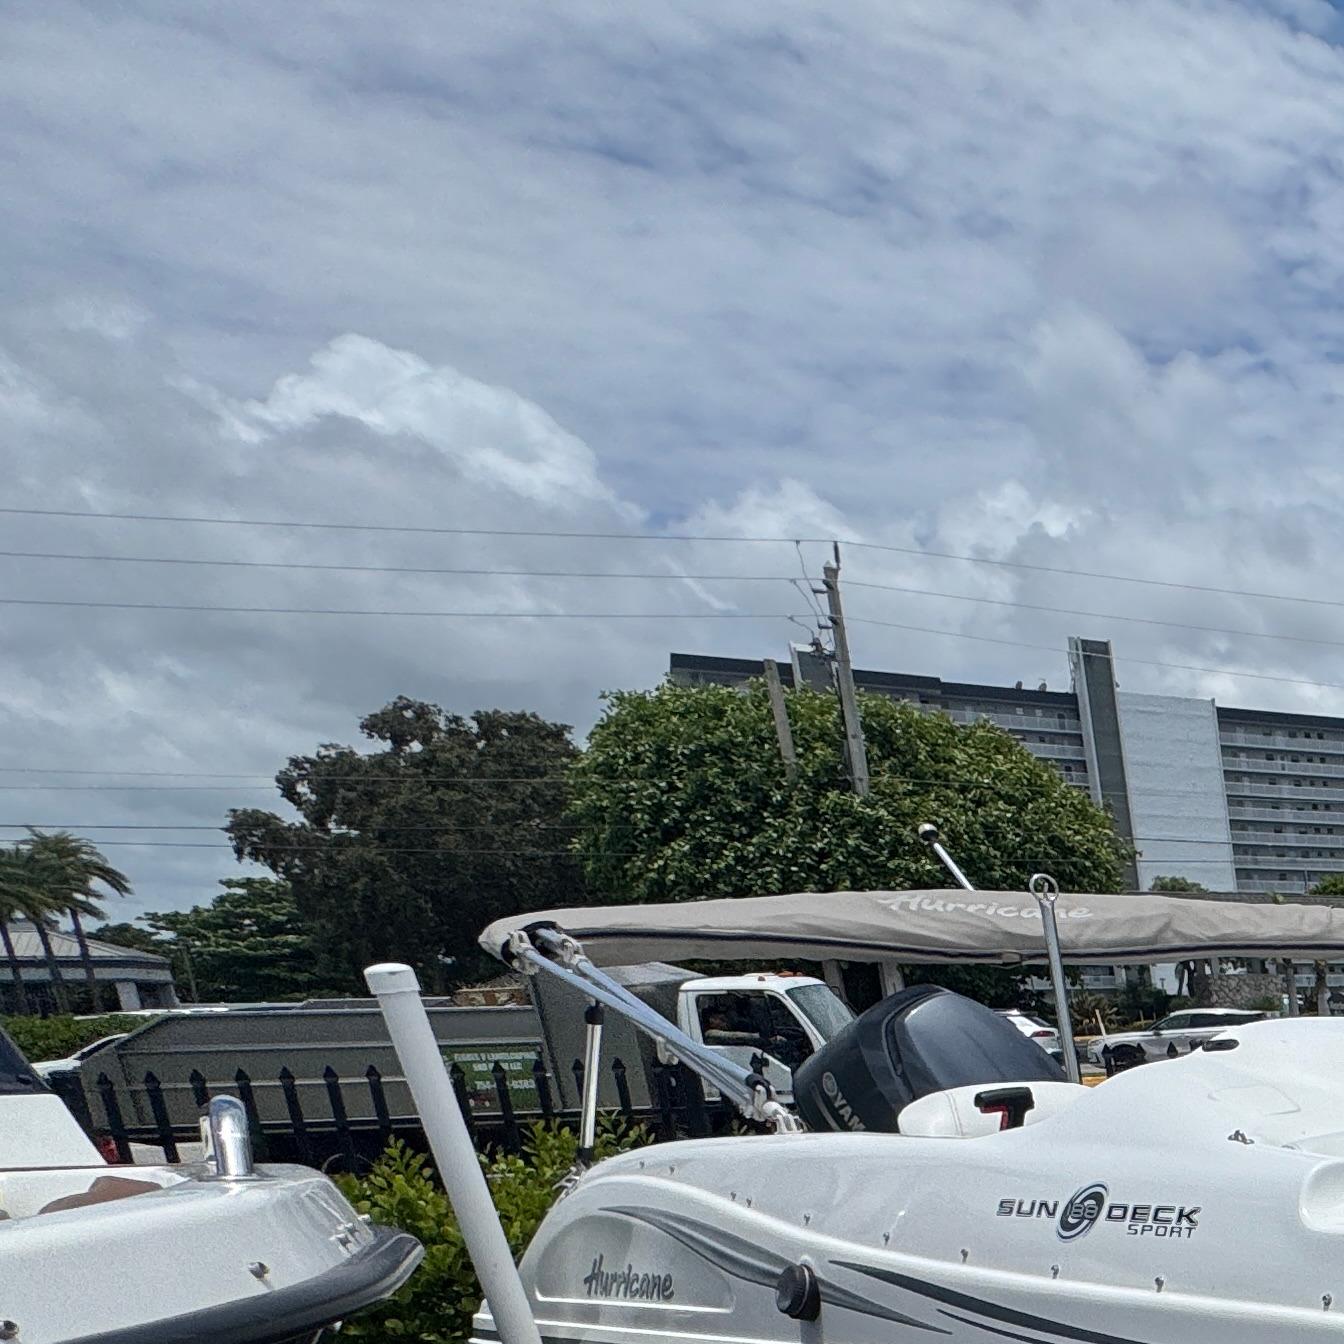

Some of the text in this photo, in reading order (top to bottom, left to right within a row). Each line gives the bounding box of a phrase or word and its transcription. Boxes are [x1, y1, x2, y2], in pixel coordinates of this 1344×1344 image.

[996, 1198, 1059, 1219] SUN
[1104, 1203, 1201, 1225] DECK
[1127, 1223, 1196, 1238] SPORT
[583, 1253, 675, 1300] Hurricane
